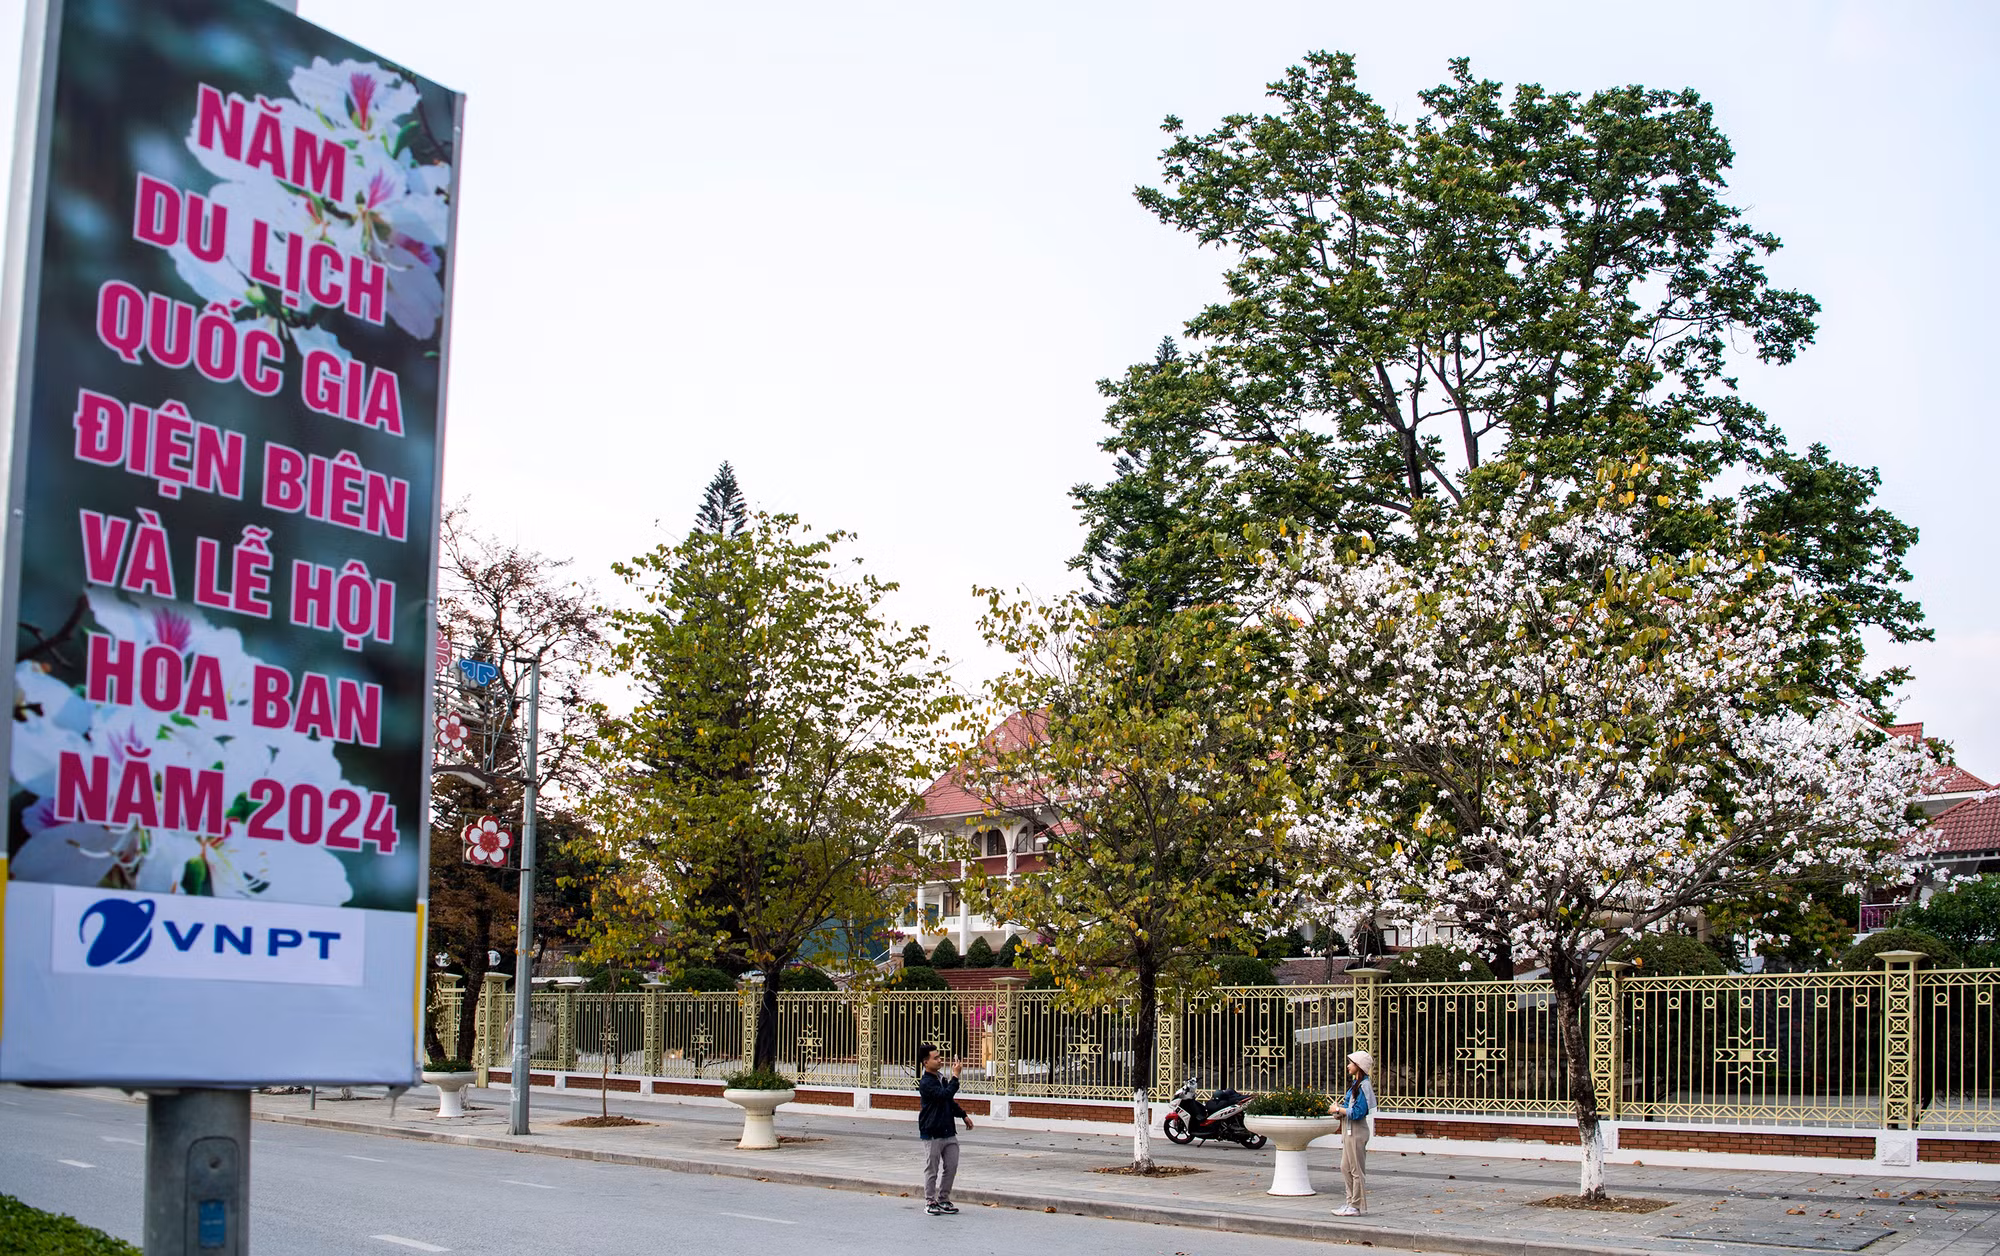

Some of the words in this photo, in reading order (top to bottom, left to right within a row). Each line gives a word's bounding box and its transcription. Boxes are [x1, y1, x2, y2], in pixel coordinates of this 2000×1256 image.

[198, 86, 346, 202] NĂM
[136, 175, 228, 263] DU
[250, 219, 385, 323] LỊCH
[98, 282, 283, 394] QUỐC
[304, 350, 403, 434] GIA
[75, 391, 244, 498] ĐIỆN
[265, 445, 407, 540] BIÊN
[83, 511, 173, 596] VÀ
[197, 527, 271, 616] LỄ
[292, 561, 394, 651] HỘI
[88, 633, 229, 722] HOA
[251, 664, 381, 746] BAN
[57, 743, 225, 835] NĂM
[245, 778, 399, 854] 2024
[163, 920, 342, 961] VNPT
